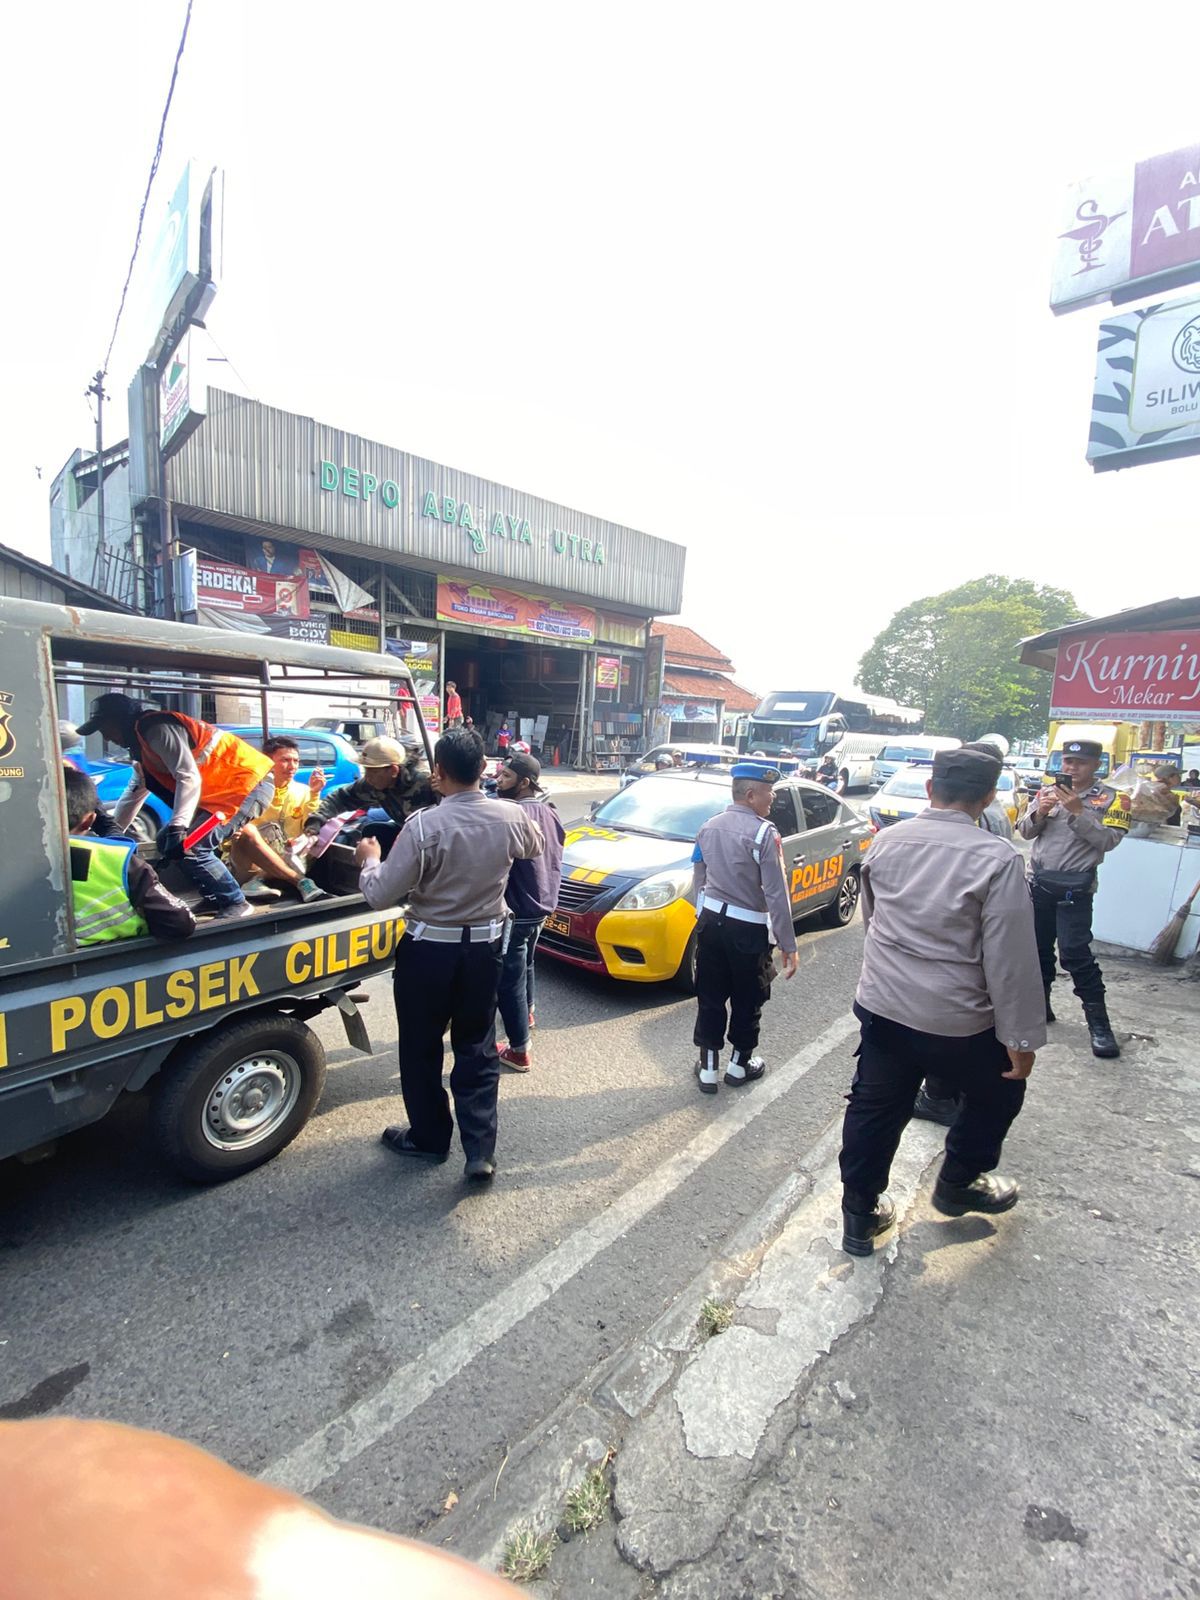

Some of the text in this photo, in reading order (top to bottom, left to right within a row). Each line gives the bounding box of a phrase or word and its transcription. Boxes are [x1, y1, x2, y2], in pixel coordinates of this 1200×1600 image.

[1179, 171, 1200, 190] A
[1171, 401, 1198, 415] BOLU
[320, 460, 401, 508] DEPO
[553, 528, 606, 564] UTRA
[289, 627, 327, 639] BODY
[407, 662, 432, 671] AGOAN
[1110, 683, 1175, 705] Mekar
[791, 854, 843, 893] POLISI
[51, 953, 261, 1053] POLSEK
